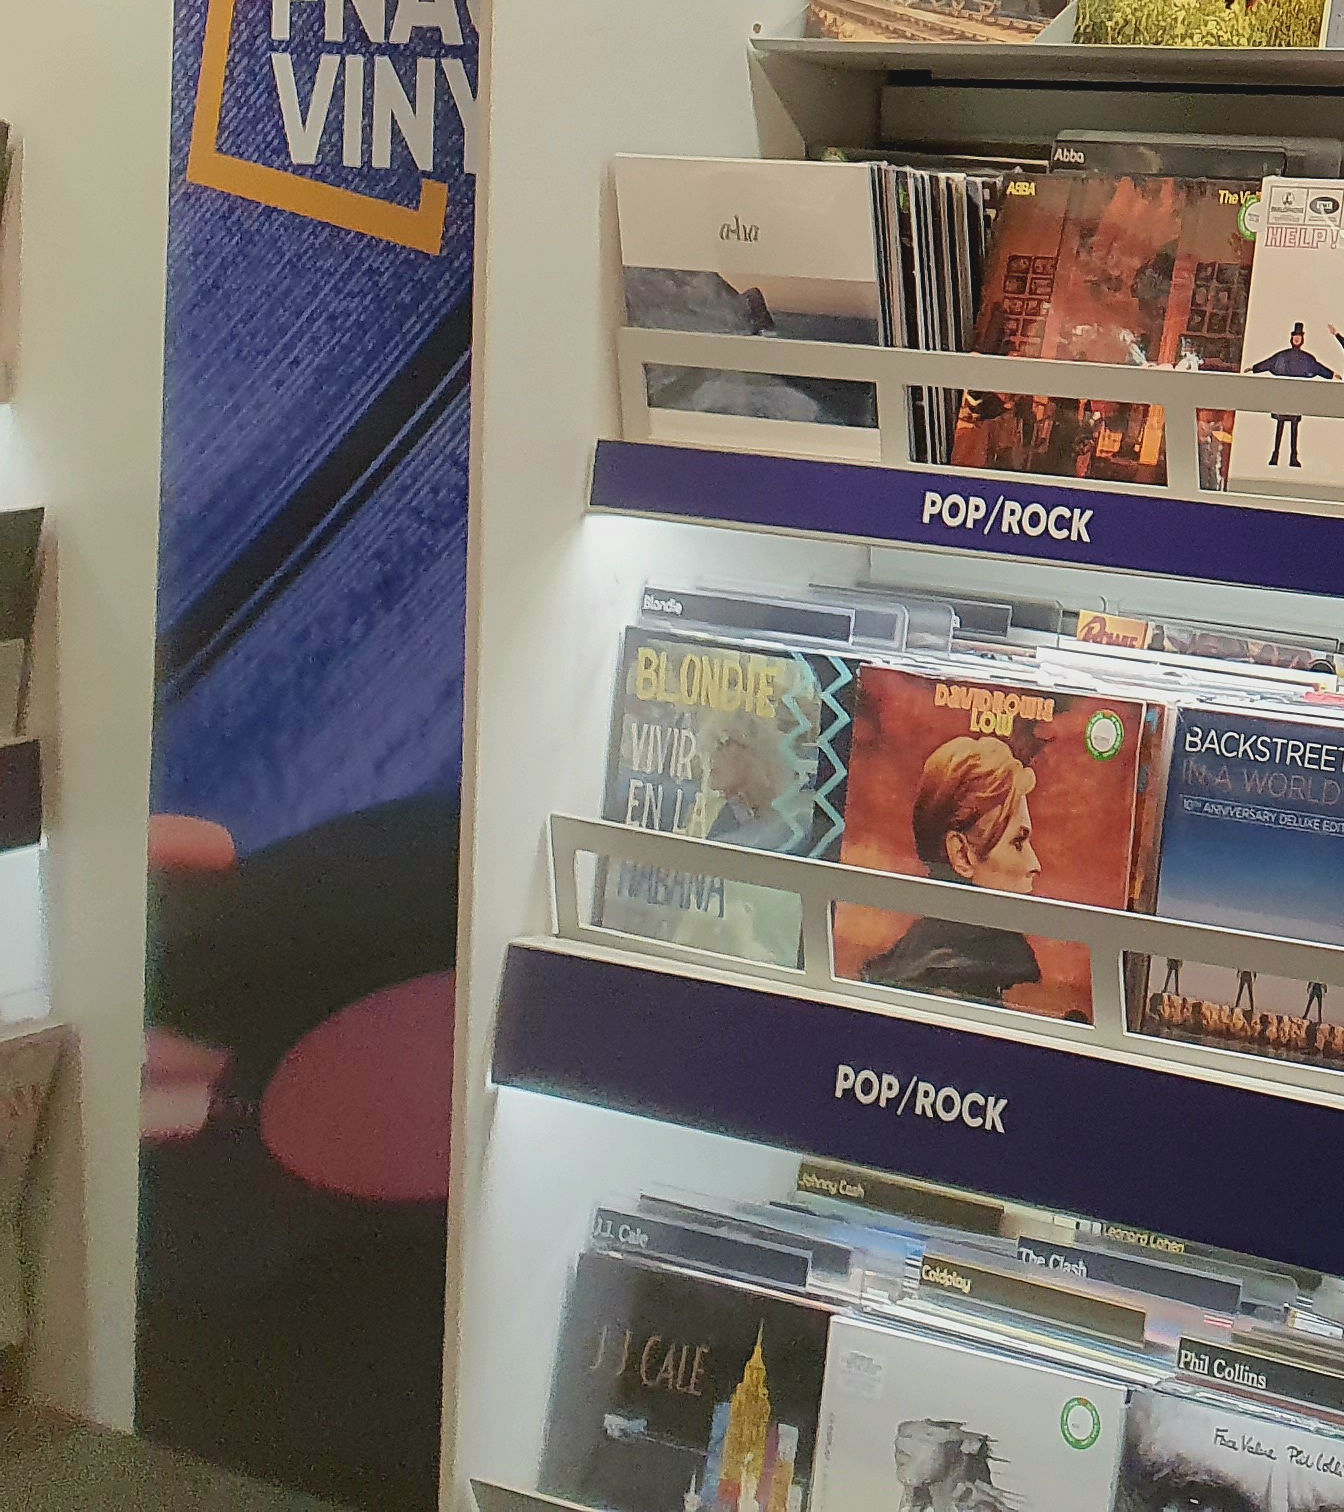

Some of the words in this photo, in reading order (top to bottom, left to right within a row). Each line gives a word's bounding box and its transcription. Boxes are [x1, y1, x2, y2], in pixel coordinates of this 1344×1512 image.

[1053, 147, 1085, 164] Abba
[1006, 181, 1036, 196] ABBA
[1219, 190, 1239, 204] The
[1264, 225, 1338, 250] HELP!
[922, 491, 1093, 544] POP/ROCK
[642, 595, 683, 615] Blondie
[636, 647, 779, 719] BLONDIE
[968, 707, 1015, 738] LOW
[630, 723, 697, 786] VIVIR
[1213, 765, 1233, 791] A
[1241, 769, 1342, 806] WORLD
[627, 780, 663, 830] EN
[1203, 803, 1277, 825] ANNIVERSARY
[1279, 815, 1321, 832] DELUXE
[836, 1063, 1009, 1134] POP/ROCK
[1020, 1247, 1047, 1267] The
[1049, 1253, 1089, 1278] Clash
[922, 1264, 972, 1294] Coldplay
[640, 1335, 710, 1398] CALE
[1179, 1350, 1209, 1375] Phil
[1212, 1357, 1268, 1390] Collins
